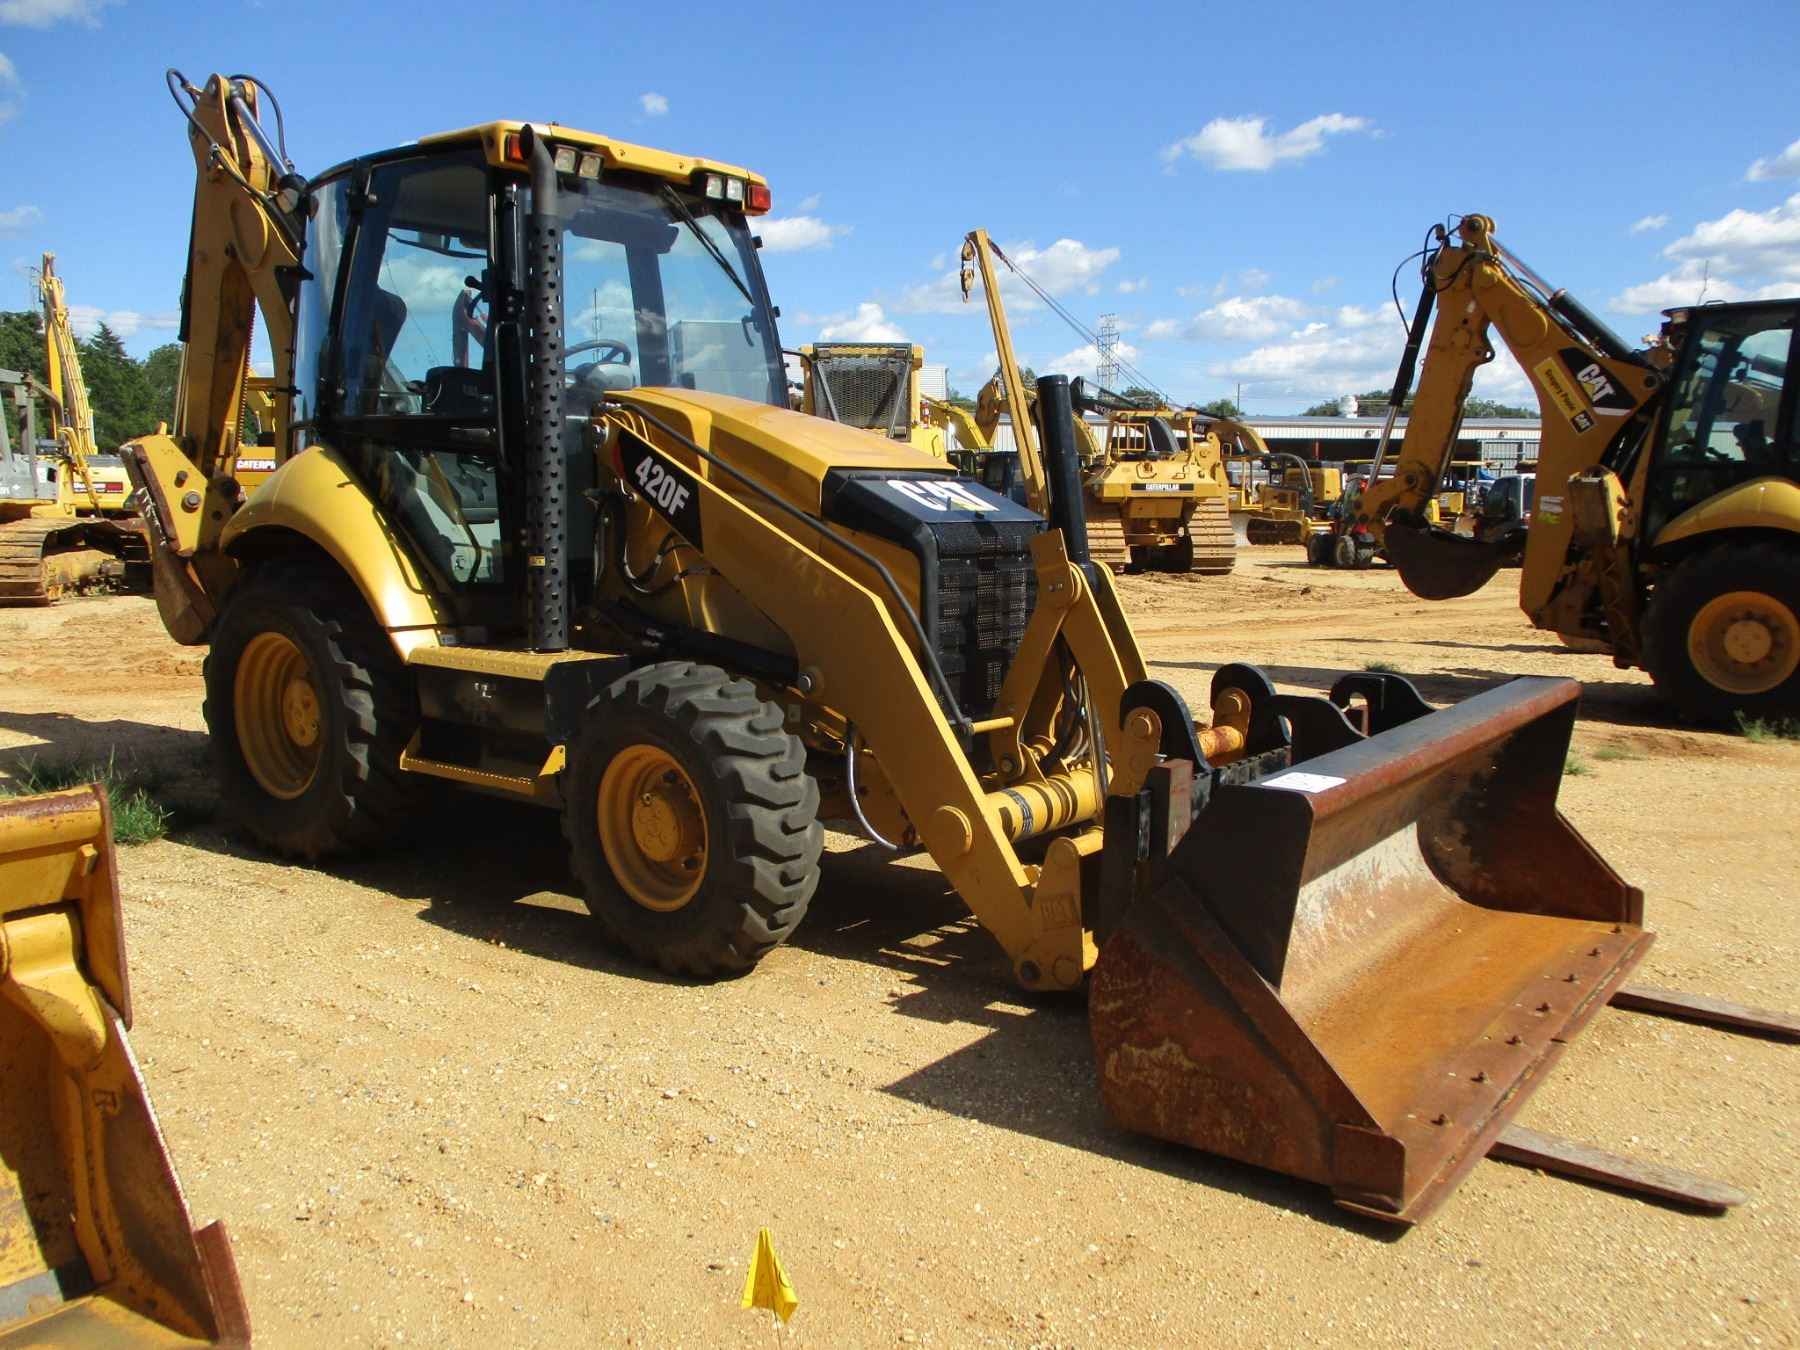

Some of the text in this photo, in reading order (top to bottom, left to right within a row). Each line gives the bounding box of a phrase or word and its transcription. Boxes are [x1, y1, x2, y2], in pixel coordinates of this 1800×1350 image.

[1577, 363, 1615, 402] CAT
[1094, 404, 1112, 415] VOL
[1574, 413, 1591, 430] CAT
[237, 460, 276, 469] CATERPI
[635, 455, 690, 516] 420F
[1145, 483, 1180, 491] CATERPILLAR
[887, 480, 1000, 511] CAT
